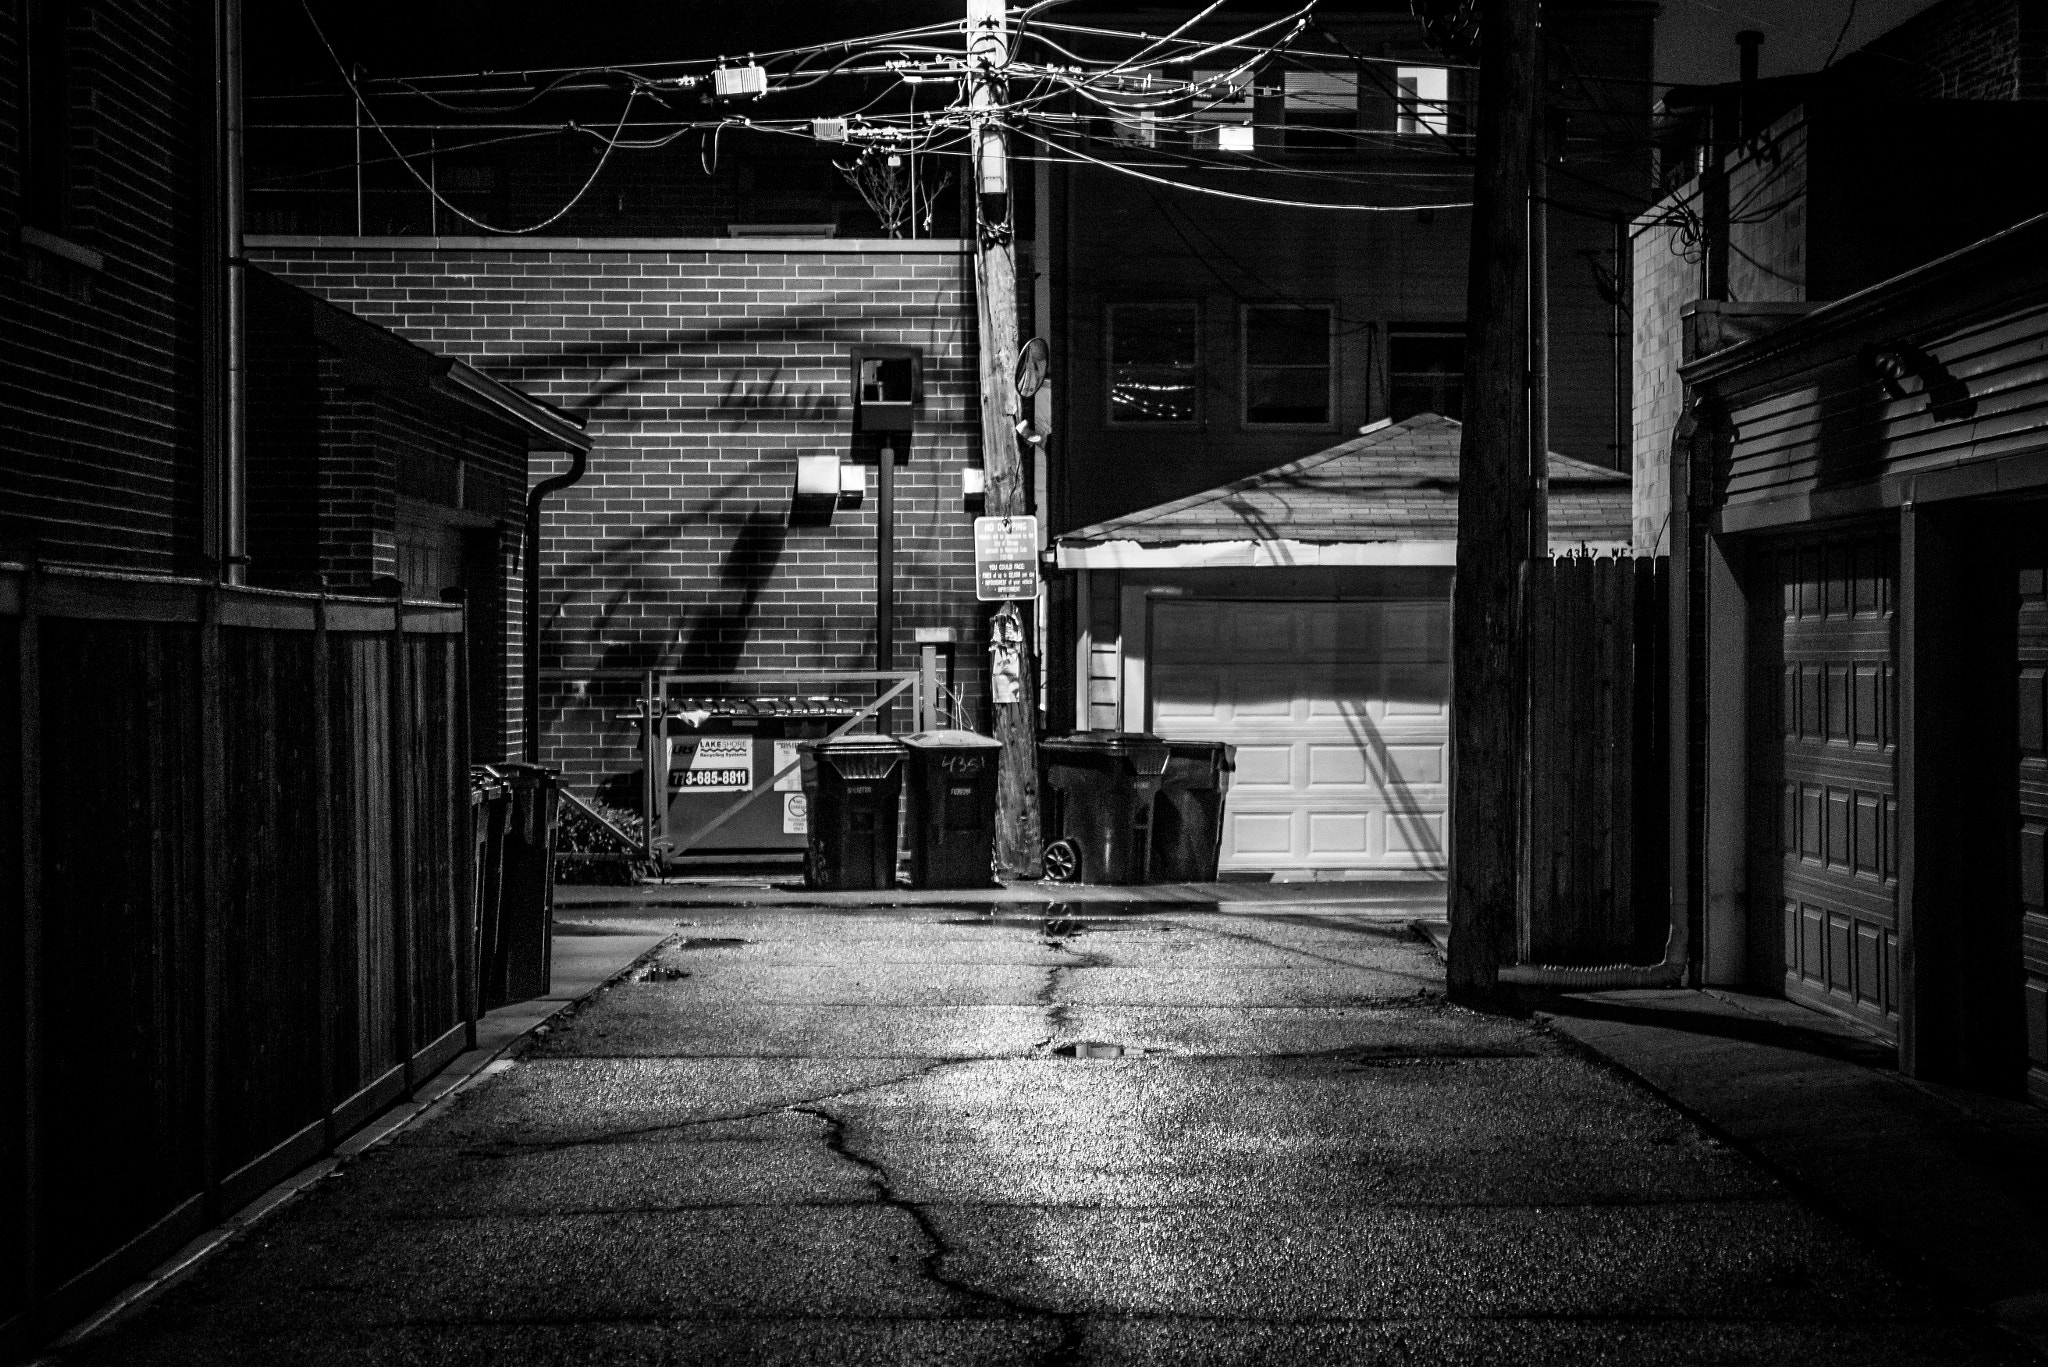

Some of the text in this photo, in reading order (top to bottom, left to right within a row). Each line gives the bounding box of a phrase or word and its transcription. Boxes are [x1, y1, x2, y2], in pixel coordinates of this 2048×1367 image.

[984, 522, 1027, 532] NO DUPING
[672, 770, 746, 785] 773-685-8811
